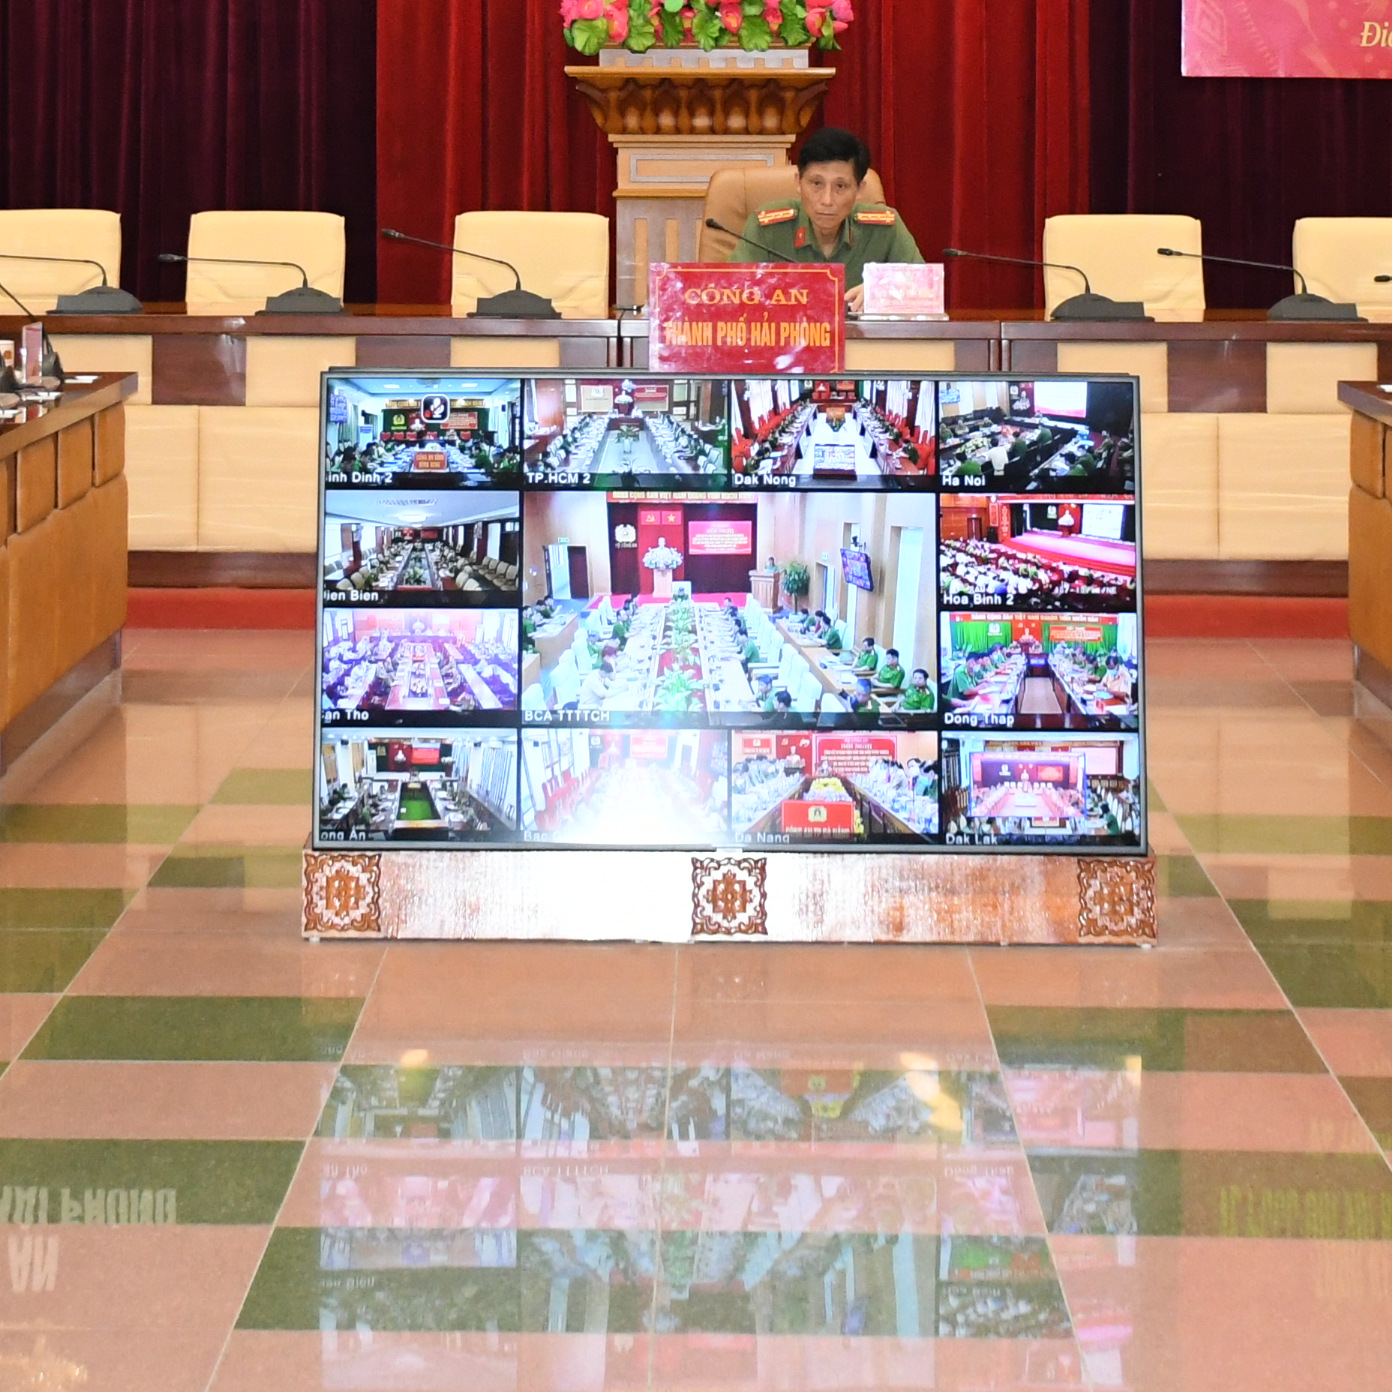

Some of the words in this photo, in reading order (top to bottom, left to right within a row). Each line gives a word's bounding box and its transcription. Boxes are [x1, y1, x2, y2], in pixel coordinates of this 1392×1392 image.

[684, 285, 760, 304] CÔNG
[770, 289, 809, 304] AN
[665, 317, 712, 346] THÀNH
[717, 313, 746, 346] PHỐ
[751, 312, 776, 346] HẢI
[780, 317, 830, 346] PHÒNG
[325, 473, 347, 483] inh
[352, 472, 381, 483] Dinh
[385, 473, 393, 483] 2
[527, 472, 578, 483] TP.HCM
[583, 472, 591, 483] 2
[734, 474, 759, 485] Dak
[763, 474, 797, 487] Nong
[942, 475, 960, 486] Ha
[964, 475, 986, 486] Noi
[324, 590, 346, 601] ien
[350, 590, 379, 601] Bien
[943, 594, 969, 605] Hoa
[973, 594, 1002, 605] Binh
[1006, 594, 1014, 605] 2
[322, 710, 340, 720] an
[345, 710, 369, 720] Tho
[524, 710, 552, 721] BCA
[558, 710, 610, 721] TTTTCH
[944, 713, 978, 727] Dong
[983, 713, 1015, 727] Thap
